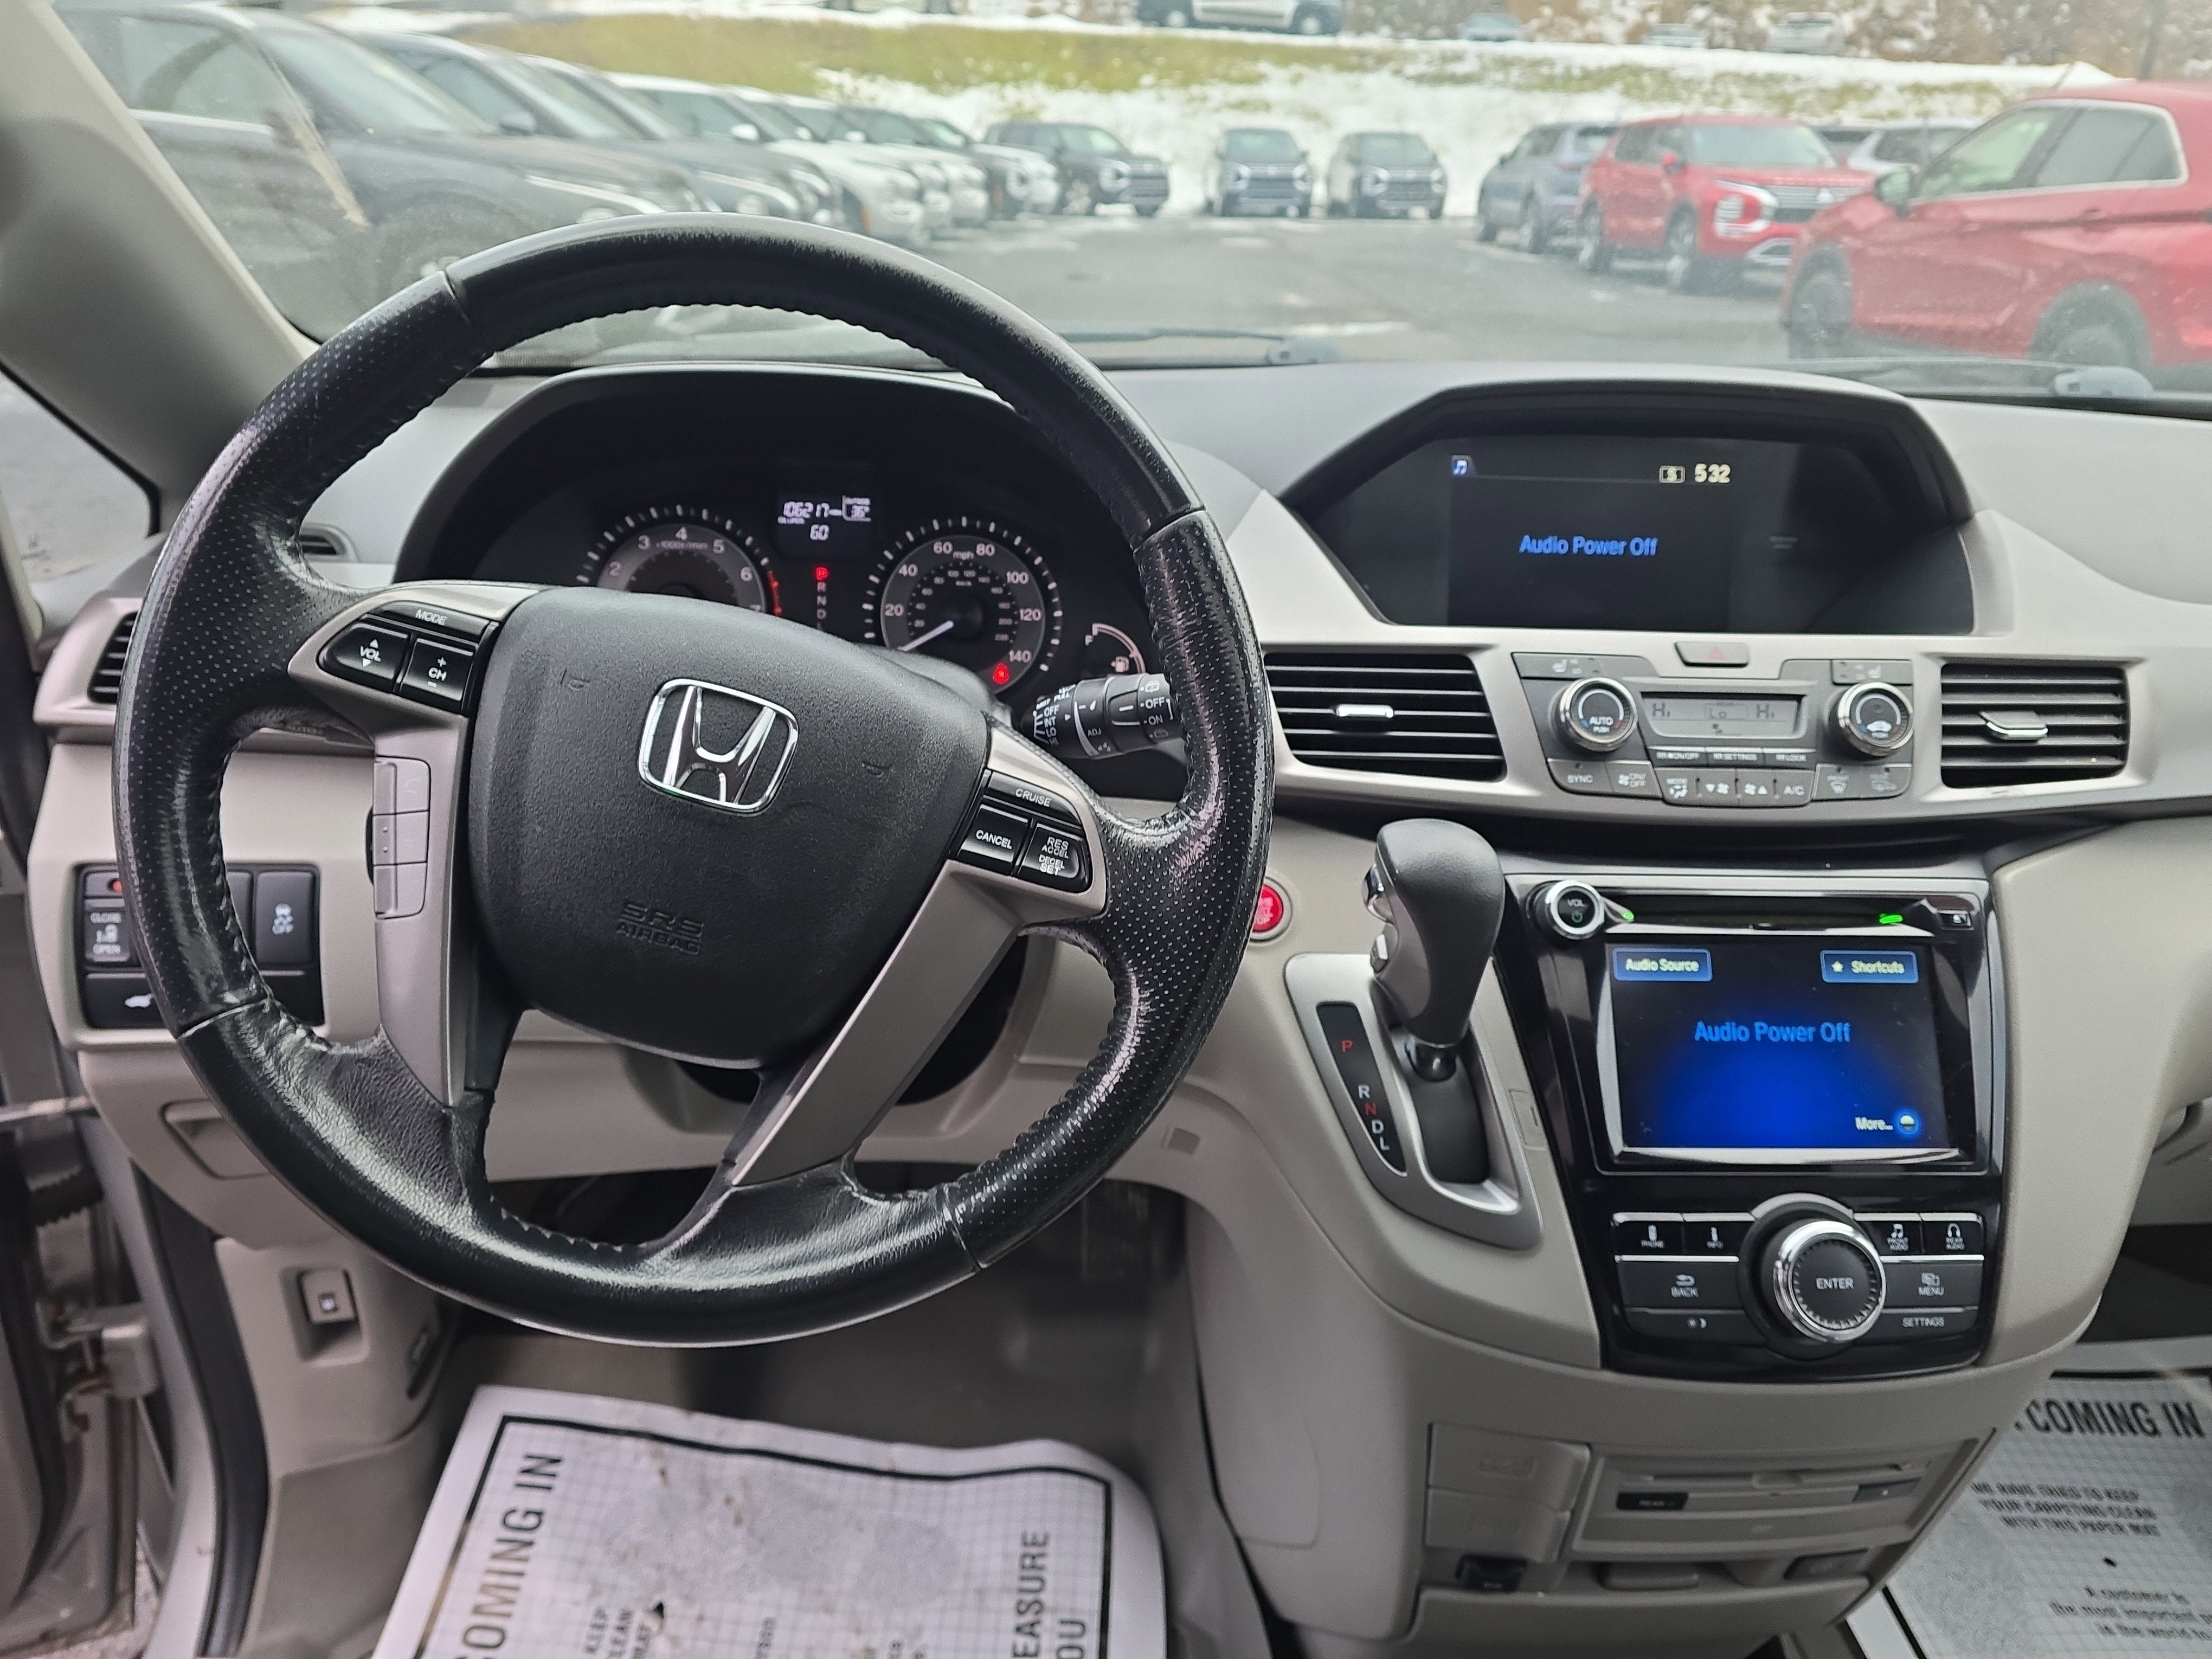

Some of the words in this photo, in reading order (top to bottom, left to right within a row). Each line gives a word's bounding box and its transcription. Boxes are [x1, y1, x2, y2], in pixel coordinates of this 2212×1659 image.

[676, 526, 687, 541] 4
[638, 535, 650, 550] 3
[713, 539, 724, 554] 5
[933, 541, 953, 554] 60
[1519, 535, 1568, 555] Audio
[1573, 536, 1626, 555] Power
[1630, 537, 1658, 556] Off
[953, 551, 975, 561] mph
[976, 543, 995, 556] 80
[609, 562, 621, 576] 2
[741, 567, 753, 581] 6
[815, 567, 829, 581] P
[898, 563, 918, 577] 40
[1007, 571, 1029, 584] 100
[816, 595, 827, 606] N
[885, 603, 904, 616] 20
[1019, 608, 1041, 621] 120
[415, 609, 447, 626] MODE
[360, 645, 381, 662] VOL
[1009, 651, 1032, 663] 140
[428, 667, 447, 681] CH
[1144, 696, 1165, 709] OFF
[1044, 704, 1059, 717] OFF
[1044, 716, 1056, 728] INT
[1148, 714, 1163, 725] ON
[1589, 716, 1614, 725] AUTO
[1045, 726, 1057, 738] LO
[1088, 728, 1102, 736] ADJ
[1567, 774, 1594, 783] SYNC
[1015, 788, 1051, 807] CRUISE
[976, 829, 1013, 850] CANCEL
[1047, 837, 1069, 851] RES
[1040, 863, 1061, 876] SET
[1567, 898, 1585, 907] VOL
[1625, 958, 1658, 972] Audio
[1659, 957, 1699, 972] Source
[1851, 960, 1905, 974] Shortcuts
[1694, 1021, 1750, 1042] Audio
[1754, 1021, 1816, 1042] Power
[1820, 1021, 1851, 1043] Off
[1341, 1039, 1353, 1052] P
[1358, 1084, 1371, 1099] R
[1365, 1103, 1377, 1116] N
[1372, 1119, 1384, 1134] D
[1379, 1136, 1390, 1150] L
[1816, 1277, 1854, 1290] ENTER
[1671, 1286, 1699, 1298] BACK
[1918, 1286, 1945, 1296] MENU
[1902, 1317, 1945, 1328] SETTINGS
[2025, 1400, 2161, 1438] COMING
[2160, 1401, 2206, 1439] IN
[454, 1507, 544, 1659] OMING
[512, 1453, 562, 1490] IN
